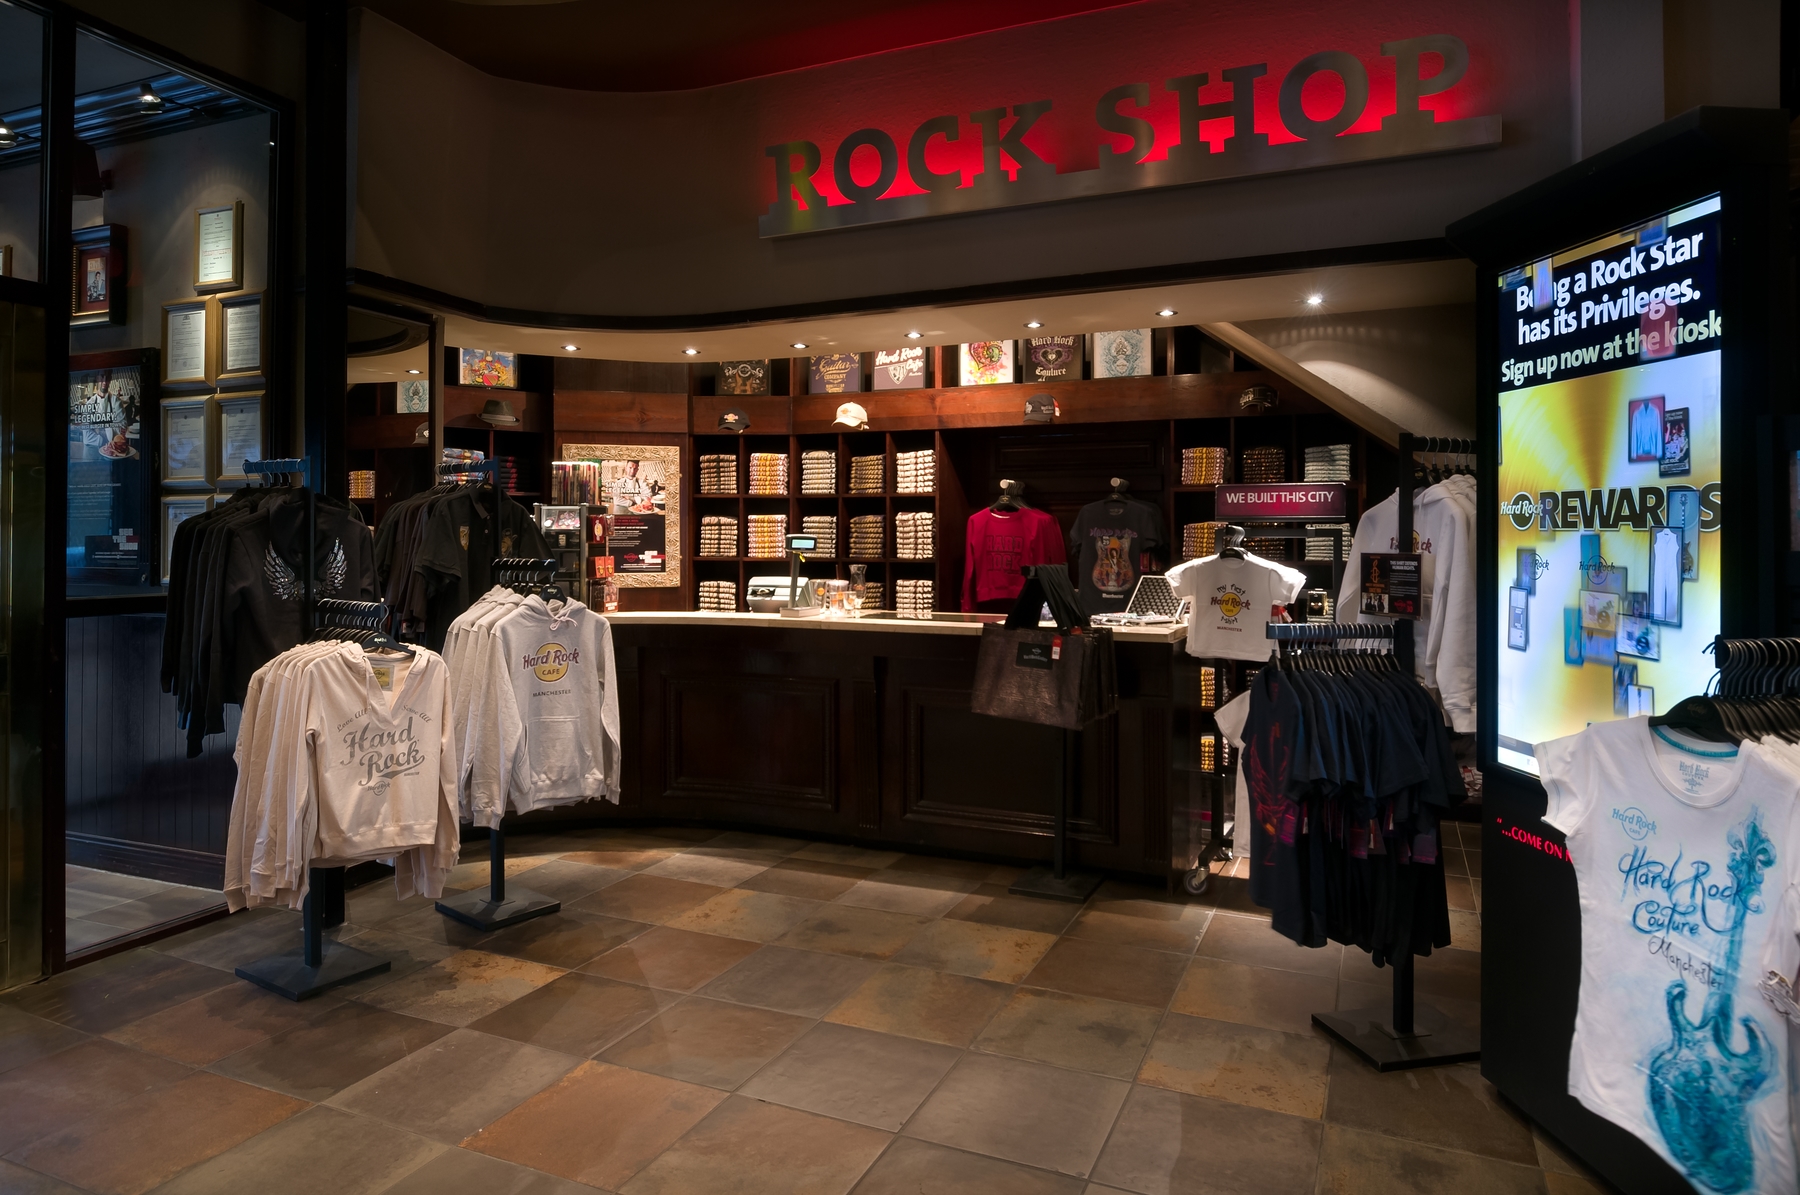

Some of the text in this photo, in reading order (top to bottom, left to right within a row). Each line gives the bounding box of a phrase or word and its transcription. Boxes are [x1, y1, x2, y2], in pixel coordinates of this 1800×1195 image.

[765, 34, 1470, 210] ROCK SHOP
[1574, 272, 1586, 294] a
[1591, 247, 1646, 289] Rock
[1650, 232, 1703, 271] Star
[1518, 278, 1701, 345] has its Privileges.
[1031, 336, 1051, 346] Hard
[1501, 310, 1721, 386] Sign up now at the kiosk
[818, 358, 851, 374] Guitar
[876, 350, 899, 365] Hard
[1035, 366, 1066, 376] Couture
[74, 403, 100, 414] SIMPLY
[1226, 491, 1334, 503] WE BUILT THIS CITY
[1500, 500, 1522, 515] Hard
[1522, 500, 1544, 517] Rock
[1579, 561, 1616, 574] Hard Rock
[1217, 584, 1246, 596] my first
[1210, 597, 1251, 610] Hard Rock
[522, 648, 579, 670] Hard Rock
[340, 716, 415, 766] Hard
[358, 740, 422, 786] Rock
[1612, 808, 1657, 835] Hard Rock
[1544, 840, 1562, 859] ON
[1618, 843, 1683, 893] Hard
[1633, 900, 1700, 935] Couture
[1648, 935, 1724, 990] Manchester
